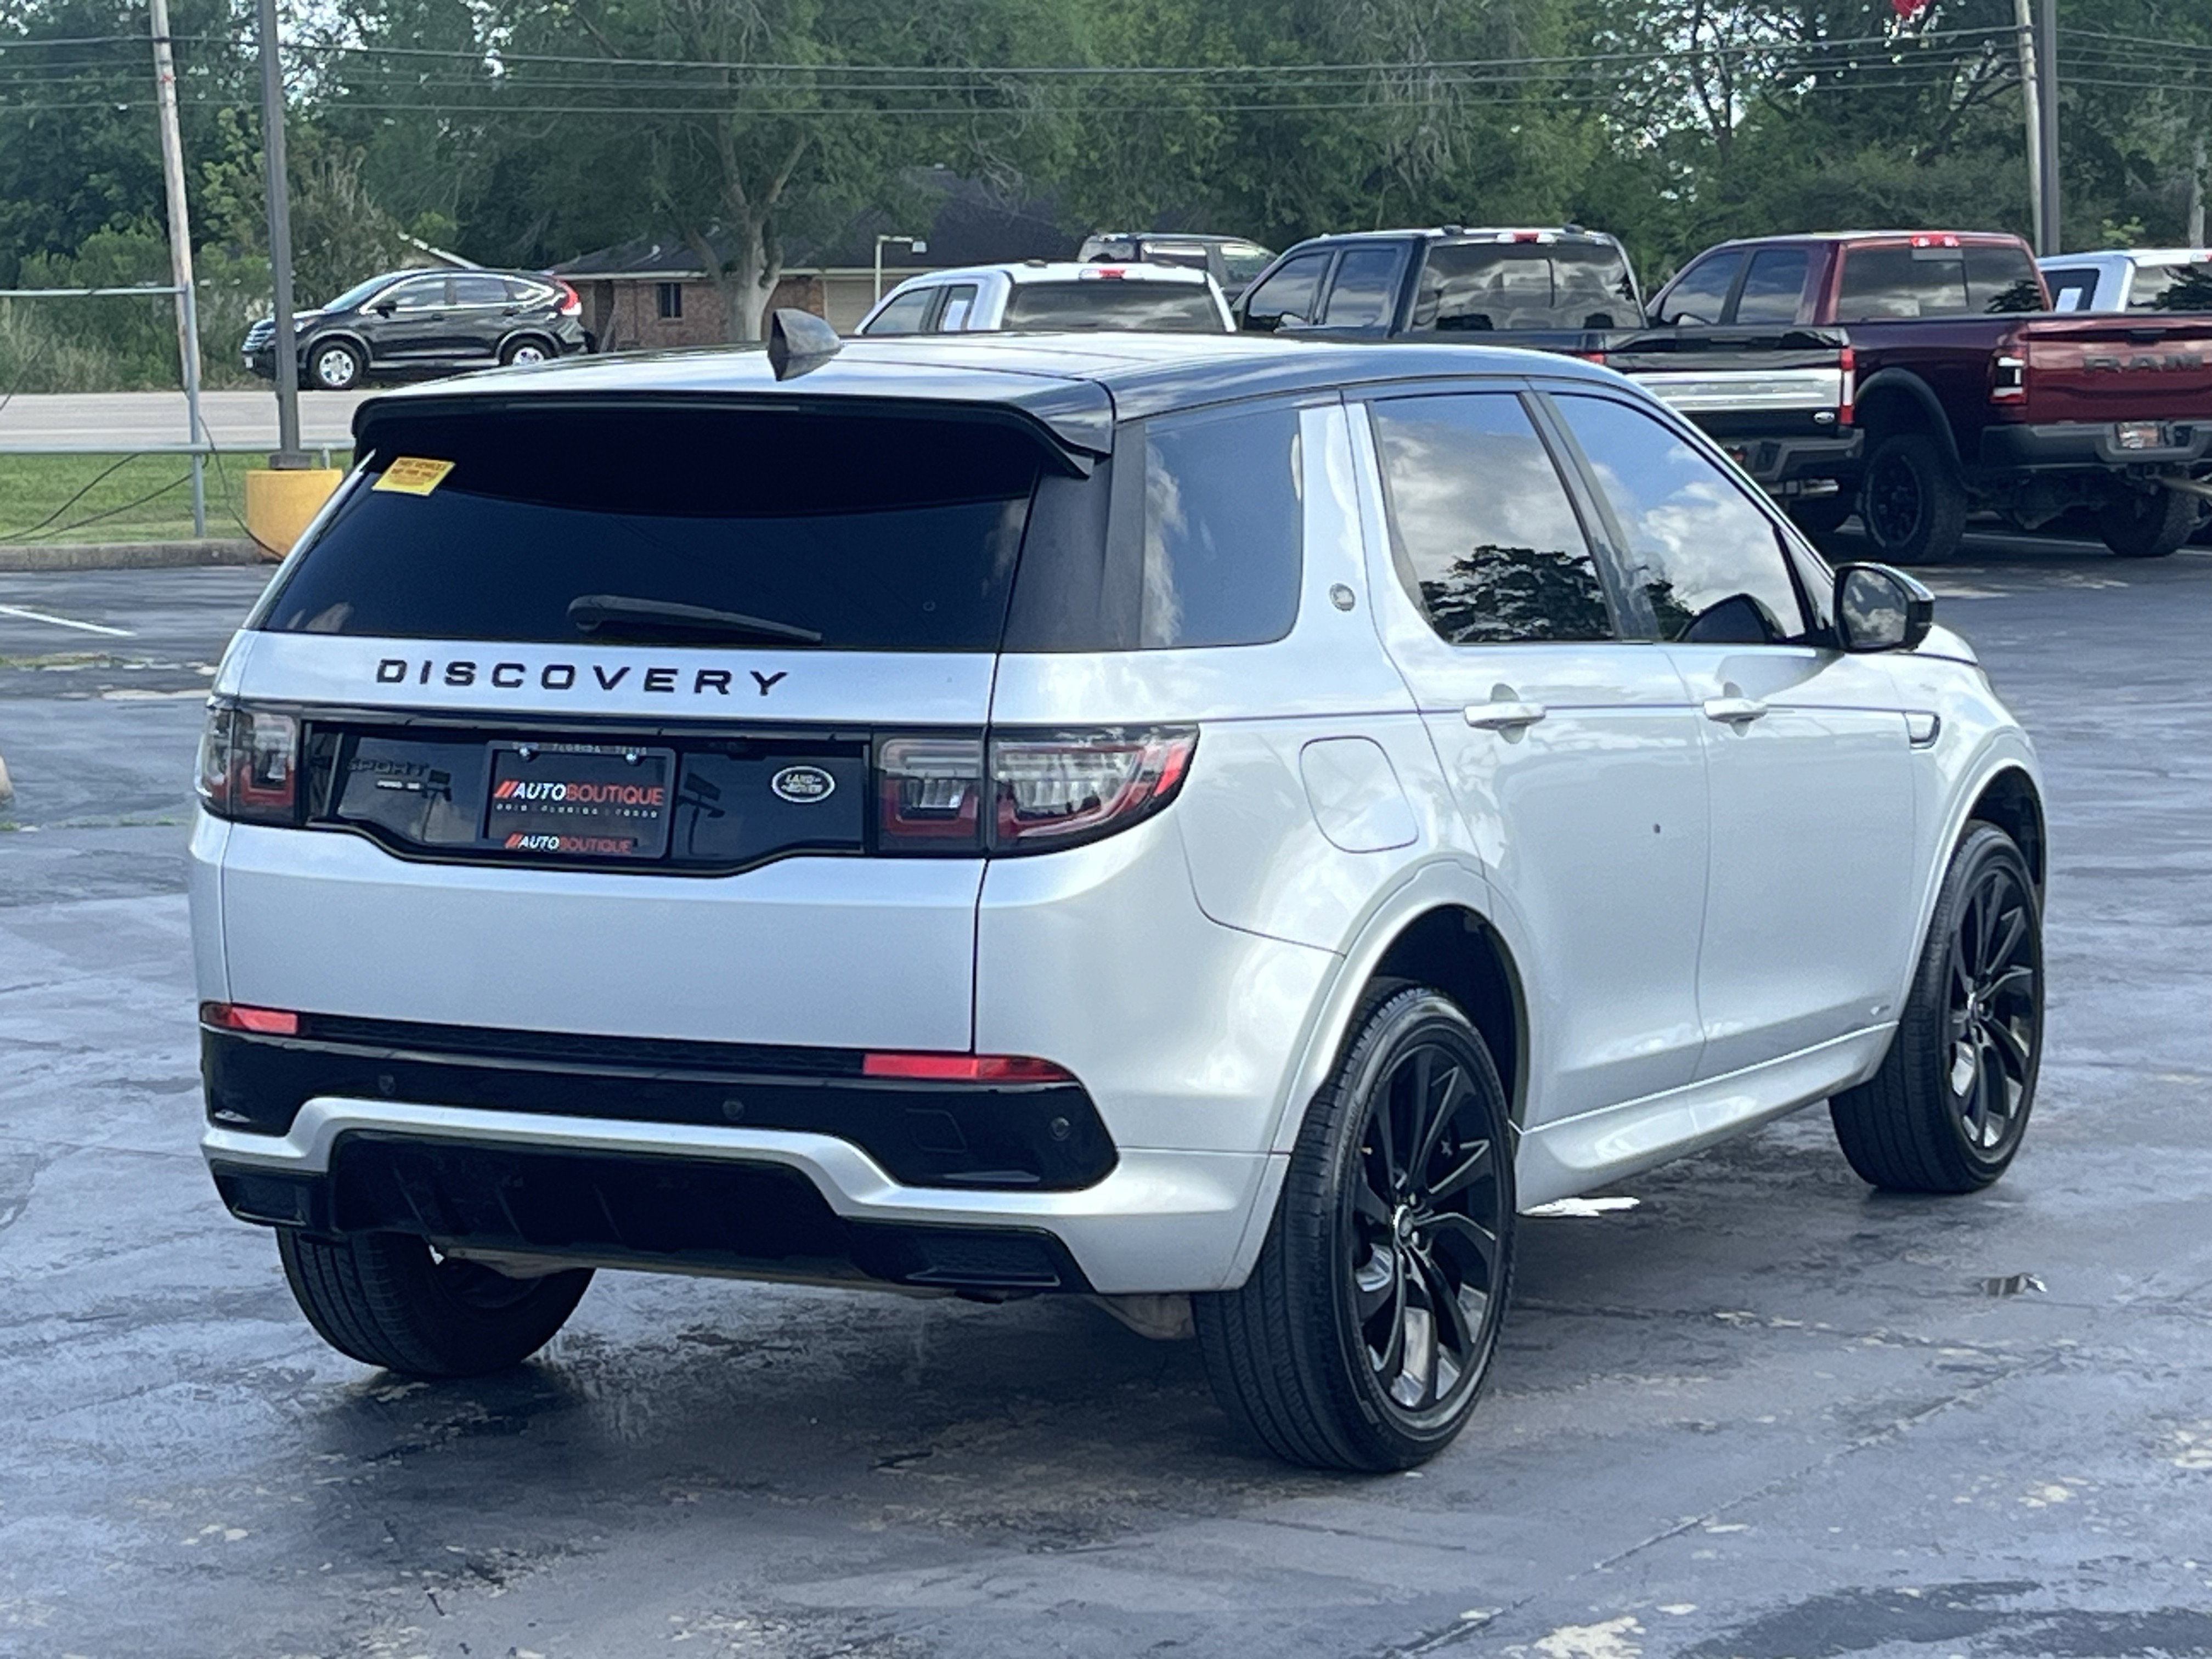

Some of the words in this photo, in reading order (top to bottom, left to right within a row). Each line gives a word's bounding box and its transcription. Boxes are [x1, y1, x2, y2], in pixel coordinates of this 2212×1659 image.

[2084, 353, 2203, 374] RAM
[376, 659, 788, 696] DISCOVERY
[512, 782, 664, 806] AUTOBOUTIQUE
[518, 836, 630, 854] AUTOBOUTIQUE
